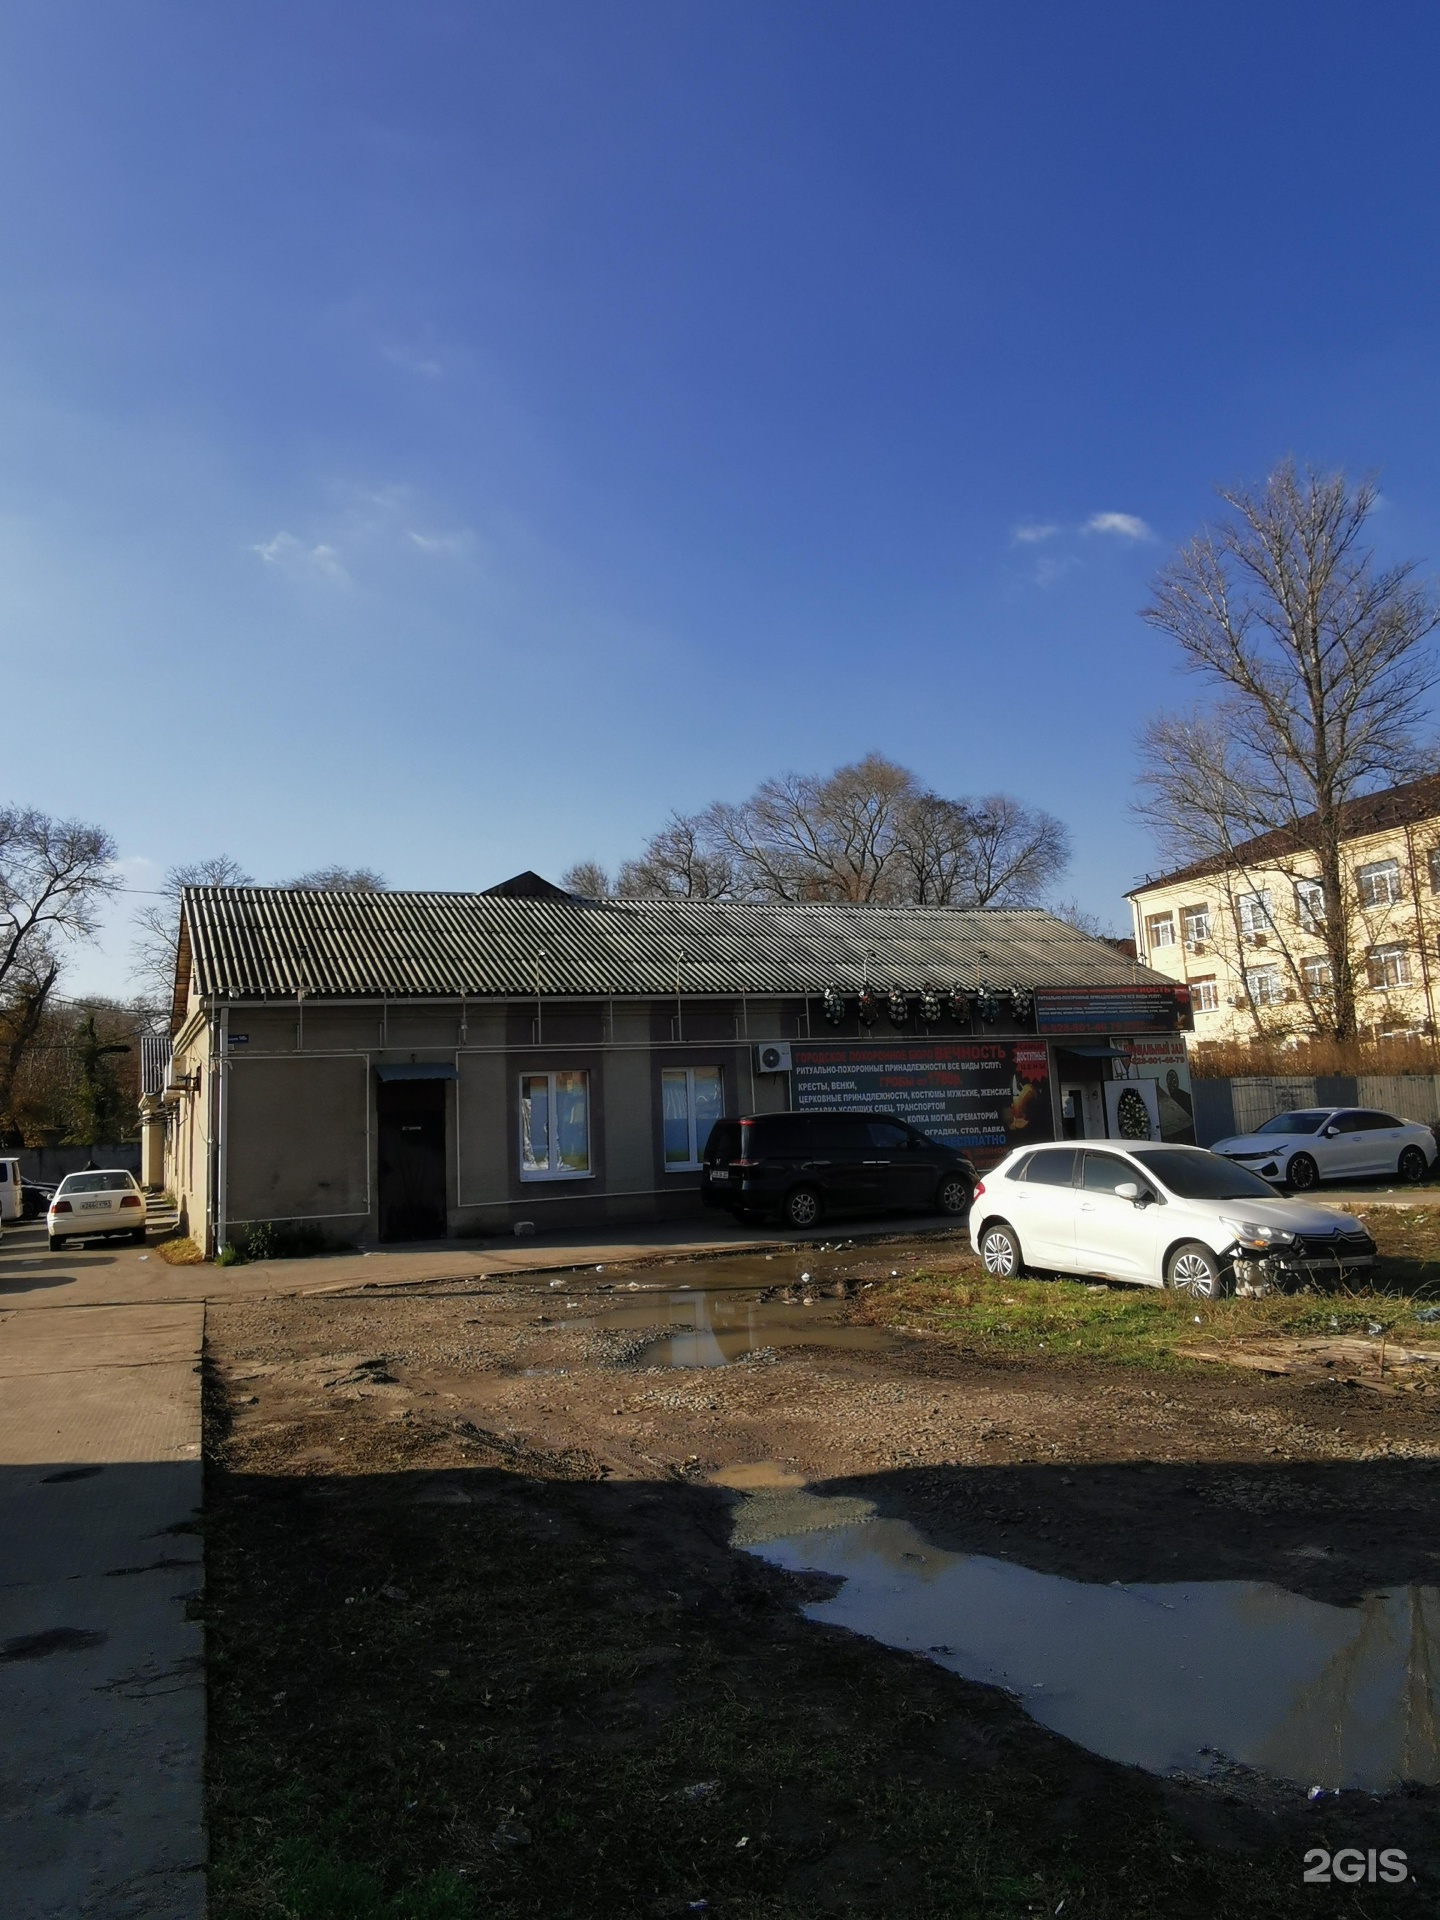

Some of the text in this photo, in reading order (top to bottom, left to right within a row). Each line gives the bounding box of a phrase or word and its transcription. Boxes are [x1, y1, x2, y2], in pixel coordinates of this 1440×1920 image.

[795, 1052, 847, 1064] ГОРОДСКОЕ
[849, 1050, 907, 1062] ПОХОРОННОЕ
[934, 1044, 1006, 1061] ВЕЧНОСТЬ
[1016, 1051, 1046, 1063] ДОСТУПНЫЕ
[796, 1061, 1002, 1075] РИТУАЛЬНО-ПОХОРОННЫЕ ПРИНАДЛЕЖНОСТИ ВСЕ ВИДЫ УСЛУГ:
[798, 1081, 857, 1091] КРЕСТЫ, ВЕНКИ,
[799, 1088, 1012, 1104] ЦЕРКОВНЫЕ ПРИНАДЛЕЖНОСТИ, КОСТЮМЫ МУЖСКИЕ, ЖЕНСКИЕ
[874, 1104, 895, 1113] СПЕЦ.
[896, 1102, 946, 1111] ТРАНСПОРТОМ
[907, 1114, 929, 1123] КОПКА
[931, 1113, 955, 1122] МОГИЛ,
[956, 1111, 998, 1121] КРЕМАТОРИЙ
[924, 1126, 1005, 1136] ОГРАДКИ, СТОЛ, ЛАВКА
